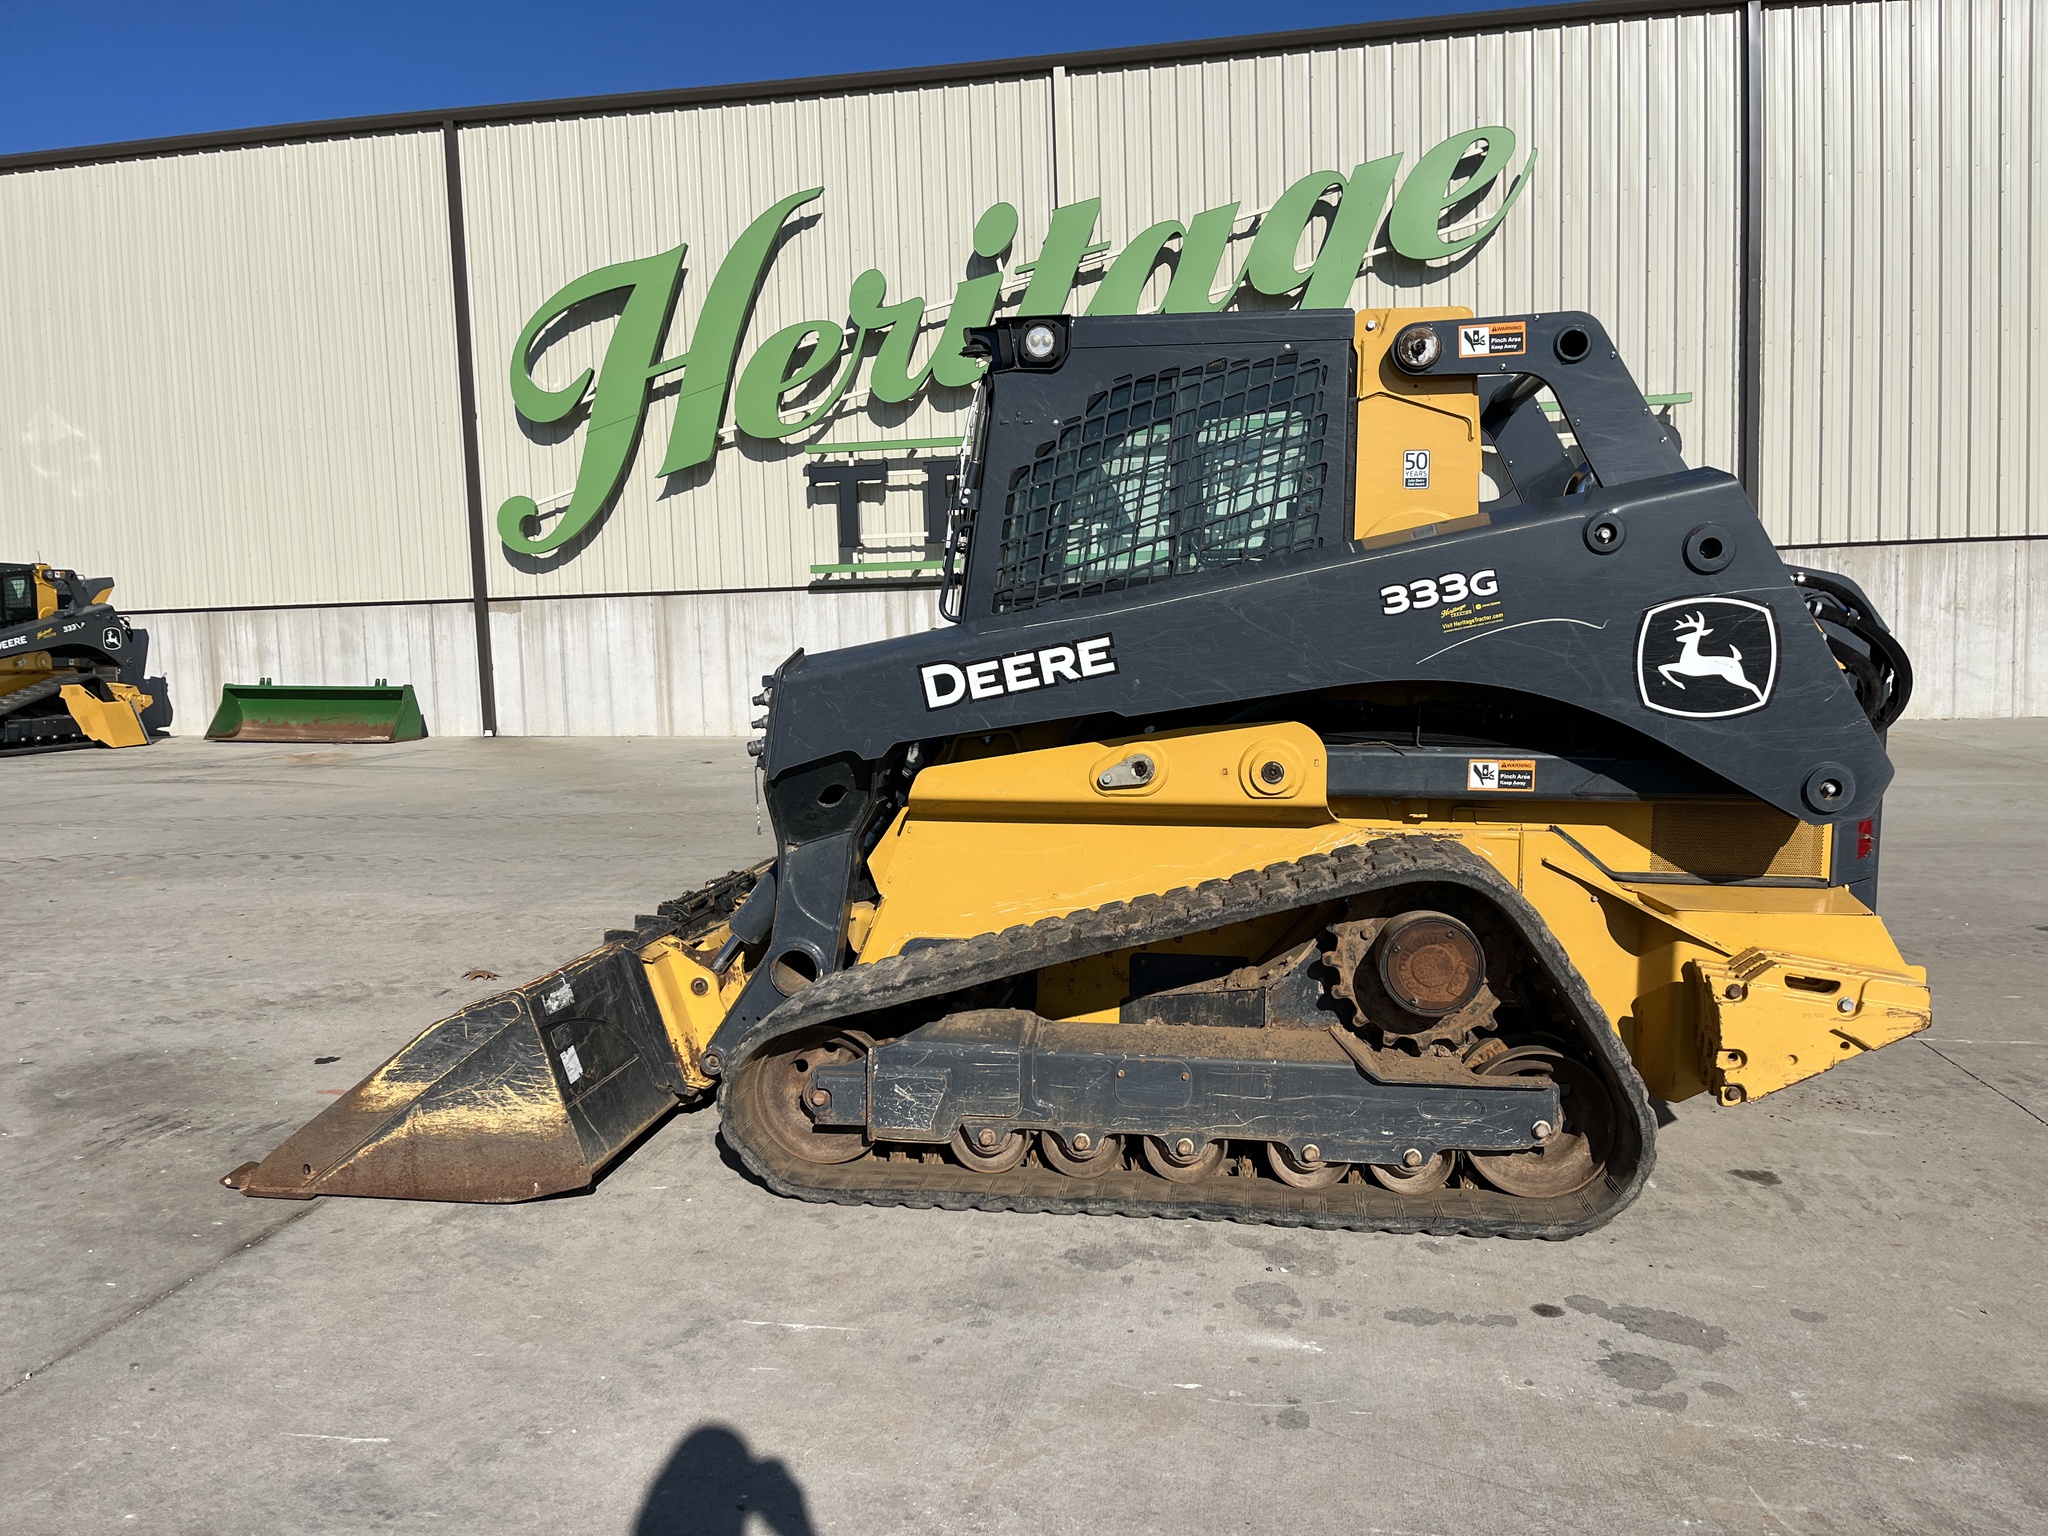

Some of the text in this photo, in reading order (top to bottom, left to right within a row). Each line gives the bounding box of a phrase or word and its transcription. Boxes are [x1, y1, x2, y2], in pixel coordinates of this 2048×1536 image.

[497, 125, 1538, 555] Heritage
[1405, 452, 1428, 470] 50
[1405, 470, 1428, 478] YEARS
[1380, 569, 1499, 616] 333G
[1453, 612, 1504, 627] HeritageTractor.com
[0, 635, 28, 651] EERE
[920, 636, 1117, 710] DEERE
